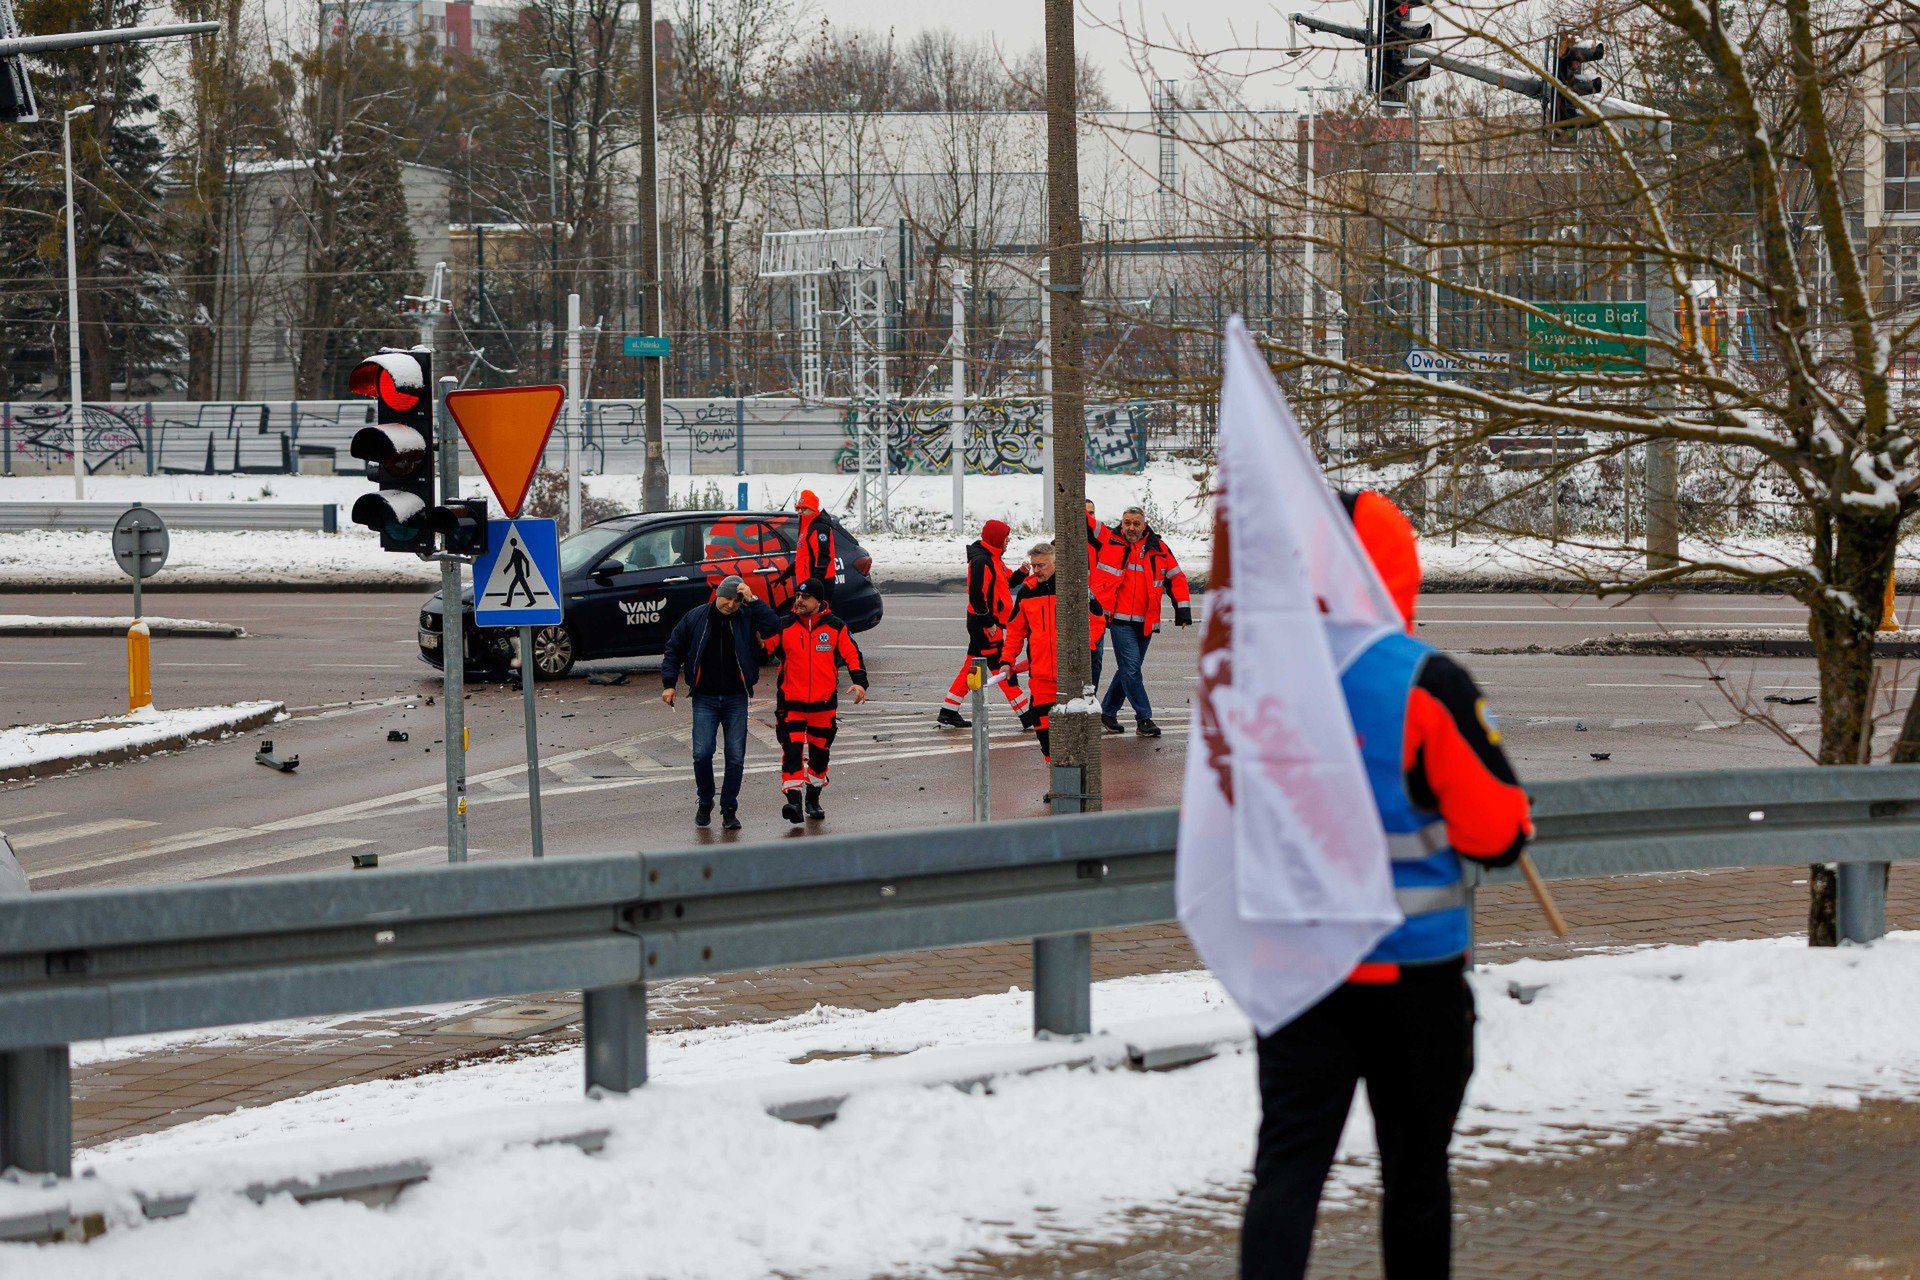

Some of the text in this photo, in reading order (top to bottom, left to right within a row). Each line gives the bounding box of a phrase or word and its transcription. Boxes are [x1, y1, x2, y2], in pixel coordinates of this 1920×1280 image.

[1534, 307, 1643, 323] Knica Biał.
[1412, 353, 1475, 369] Dworzec
[627, 600, 656, 613] VAN
[627, 613, 660, 625] KING
